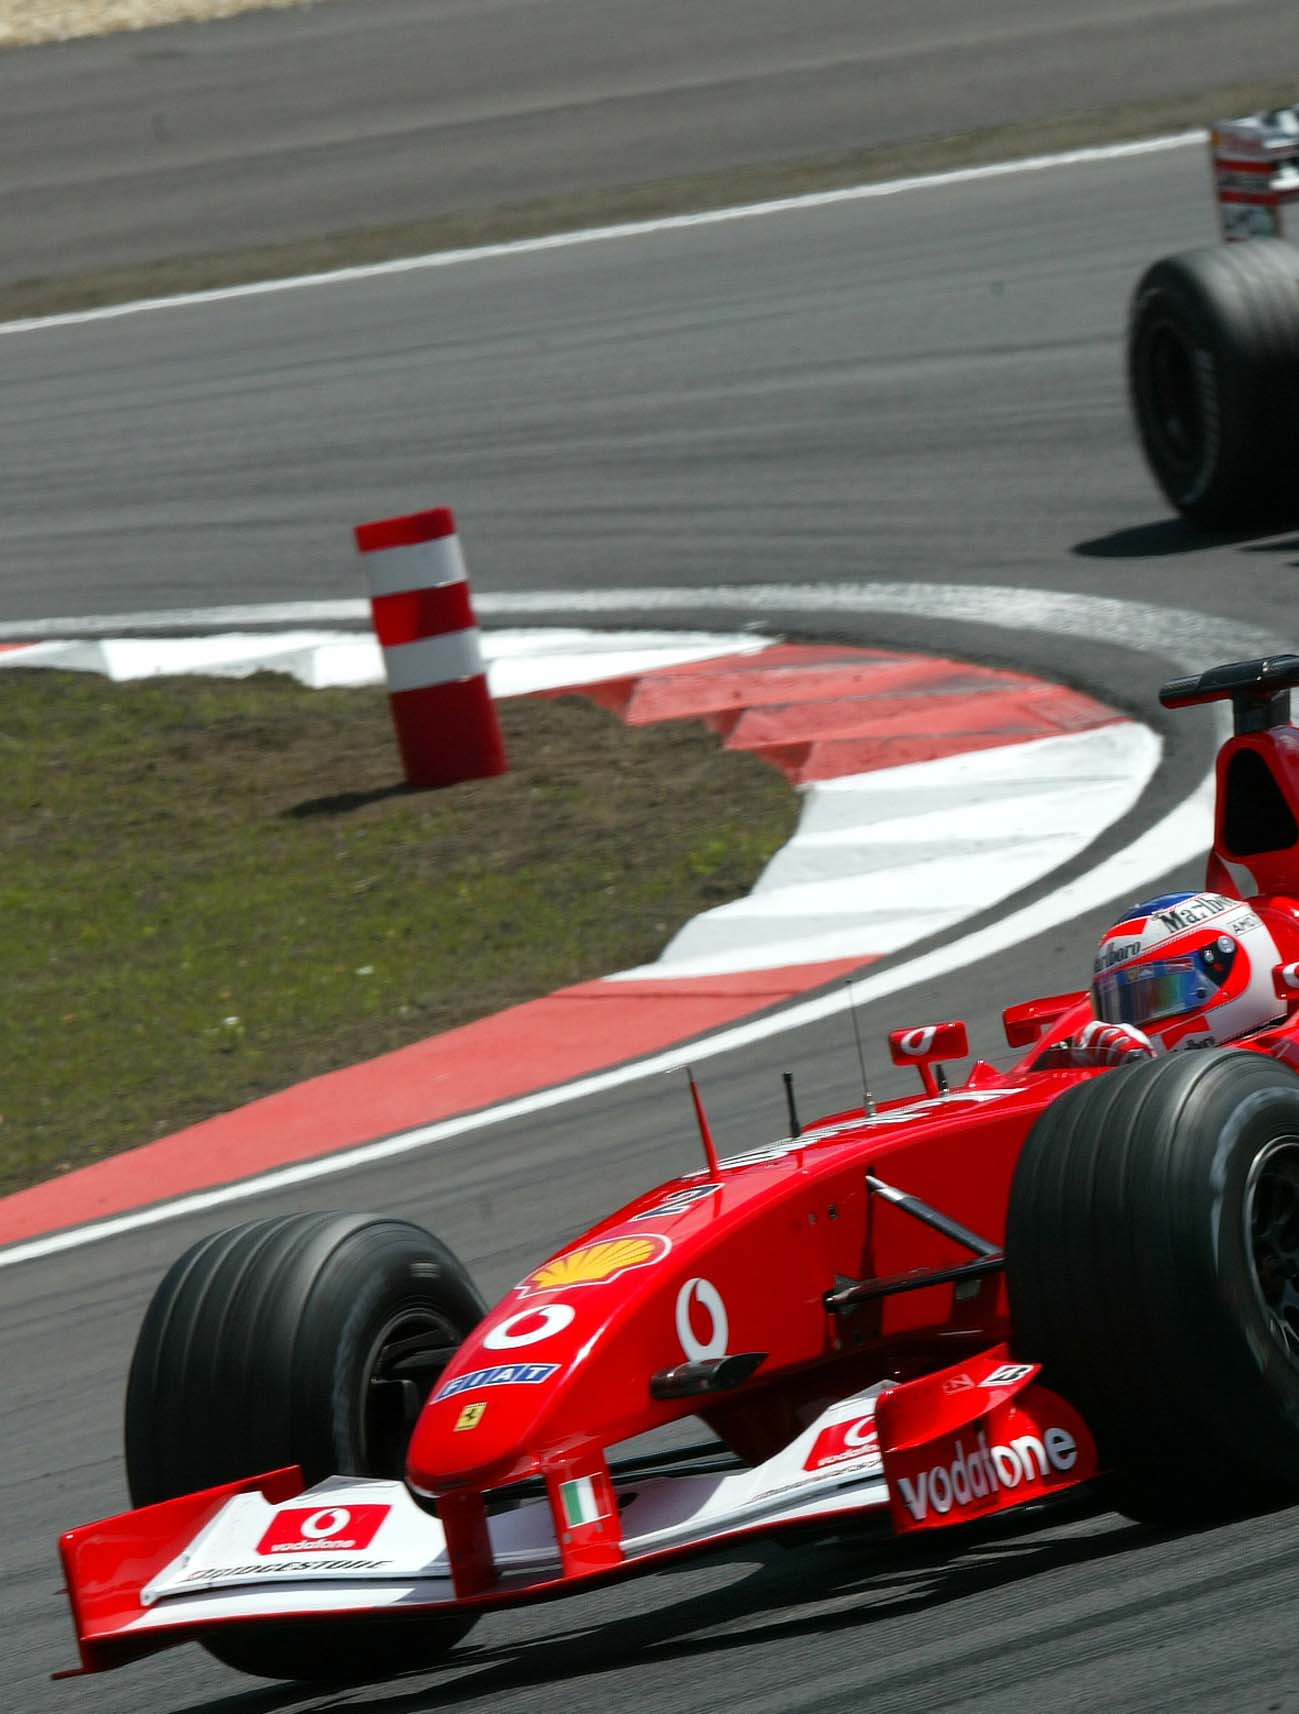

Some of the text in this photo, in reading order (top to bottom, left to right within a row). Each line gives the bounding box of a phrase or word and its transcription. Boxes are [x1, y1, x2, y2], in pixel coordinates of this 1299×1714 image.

[440, 1366, 554, 1397] FIAT
[899, 1427, 1077, 1520] vodafone
[178, 1560, 393, 1582] BRIDGESTONE
